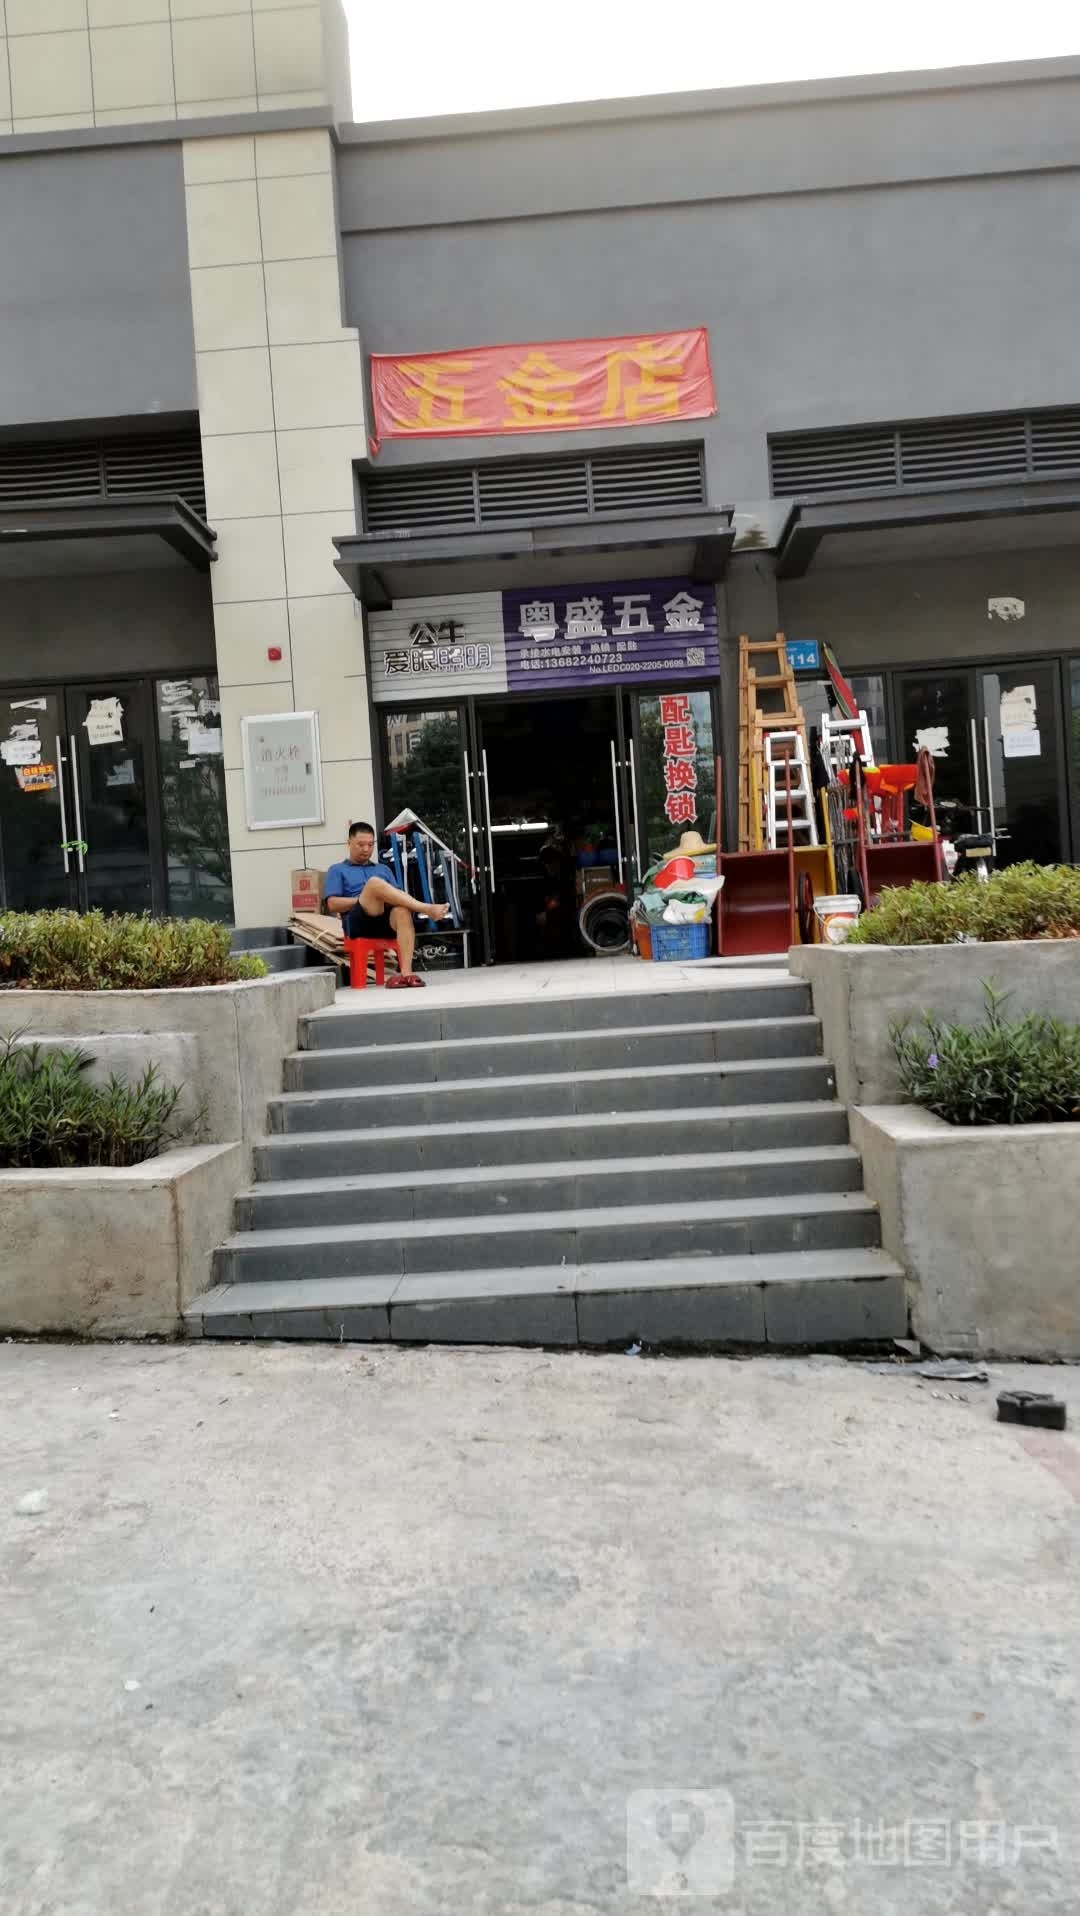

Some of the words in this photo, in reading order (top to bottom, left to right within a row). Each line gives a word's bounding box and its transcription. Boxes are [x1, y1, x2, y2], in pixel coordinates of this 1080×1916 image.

[394, 341, 685, 428] 五金店
[518, 592, 705, 642] 粤盛五金
[409, 620, 465, 647] 公牛
[384, 643, 492, 675] 爱眼照明
[519, 645, 582, 659] 承接水电安装
[787, 653, 816, 665] 114
[660, 695, 698, 823] 配匙换锁
